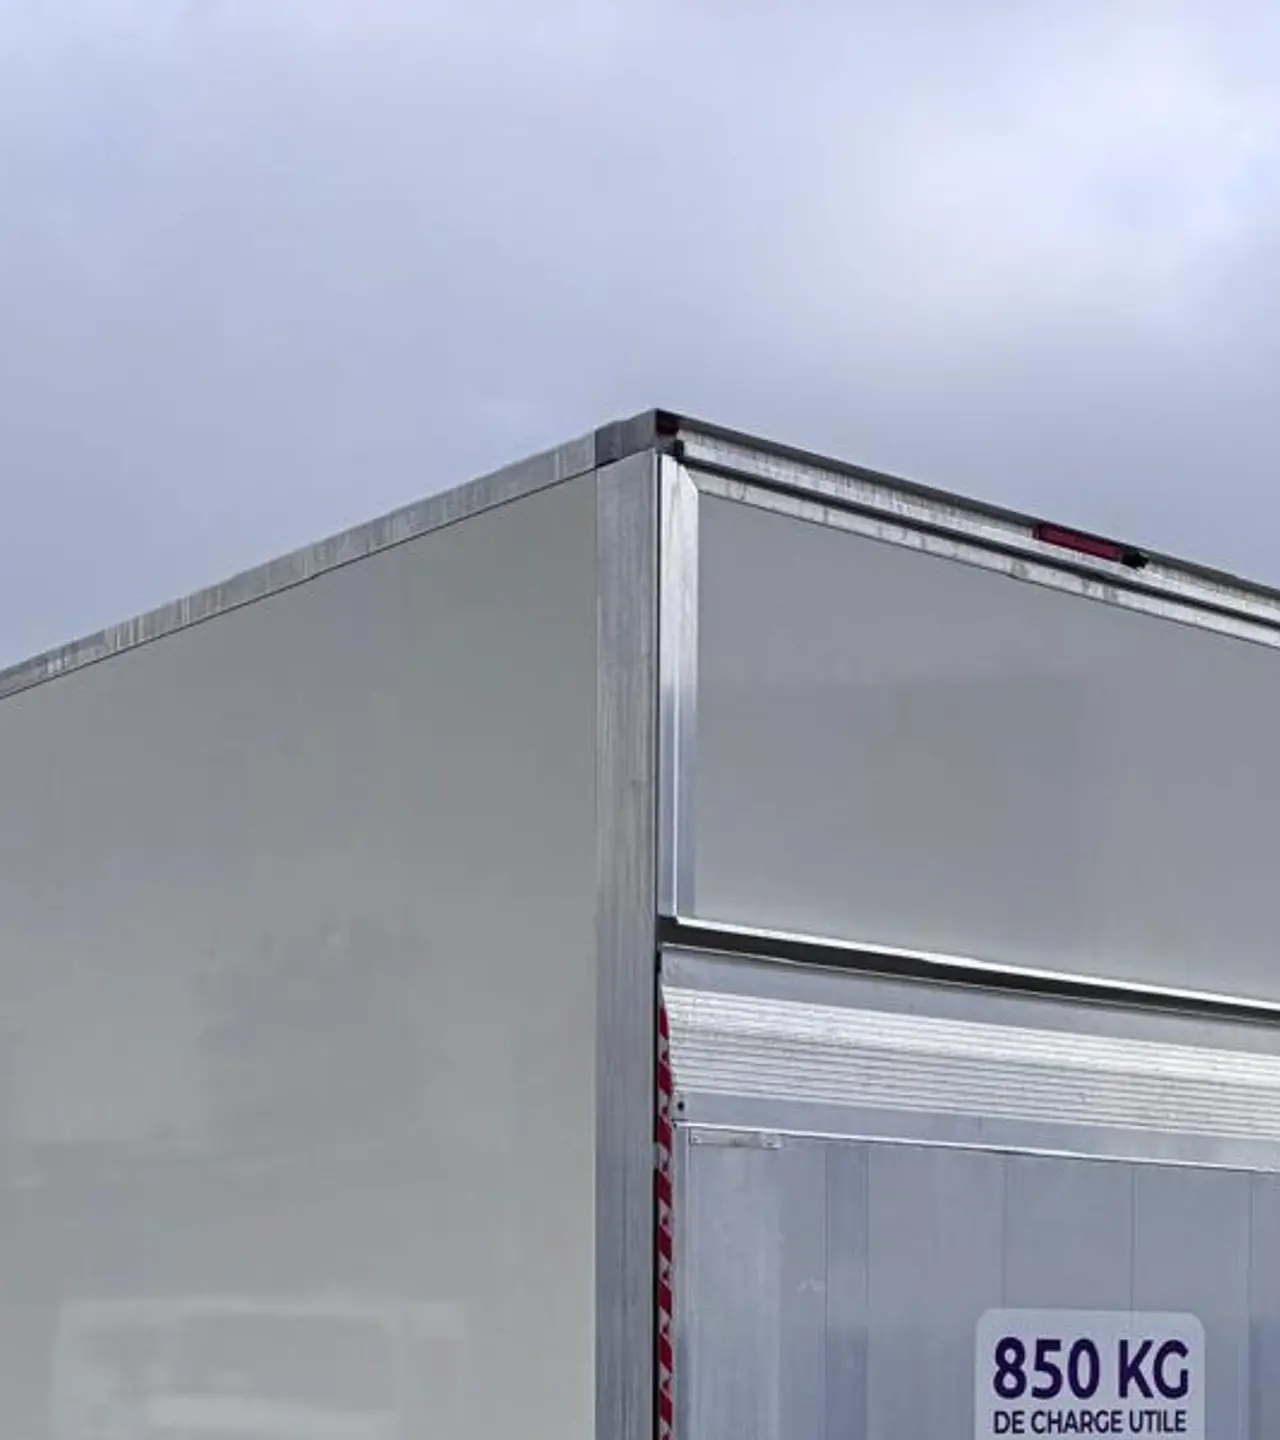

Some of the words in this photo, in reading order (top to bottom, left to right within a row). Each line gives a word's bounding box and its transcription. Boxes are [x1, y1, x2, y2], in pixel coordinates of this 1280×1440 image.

[993, 1336, 1101, 1399] 850
[1118, 1338, 1189, 1399] KG
[993, 1411, 1025, 1434] DE
[1031, 1409, 1124, 1434] CHARGE
[1129, 1409, 1188, 1433] UTILE
